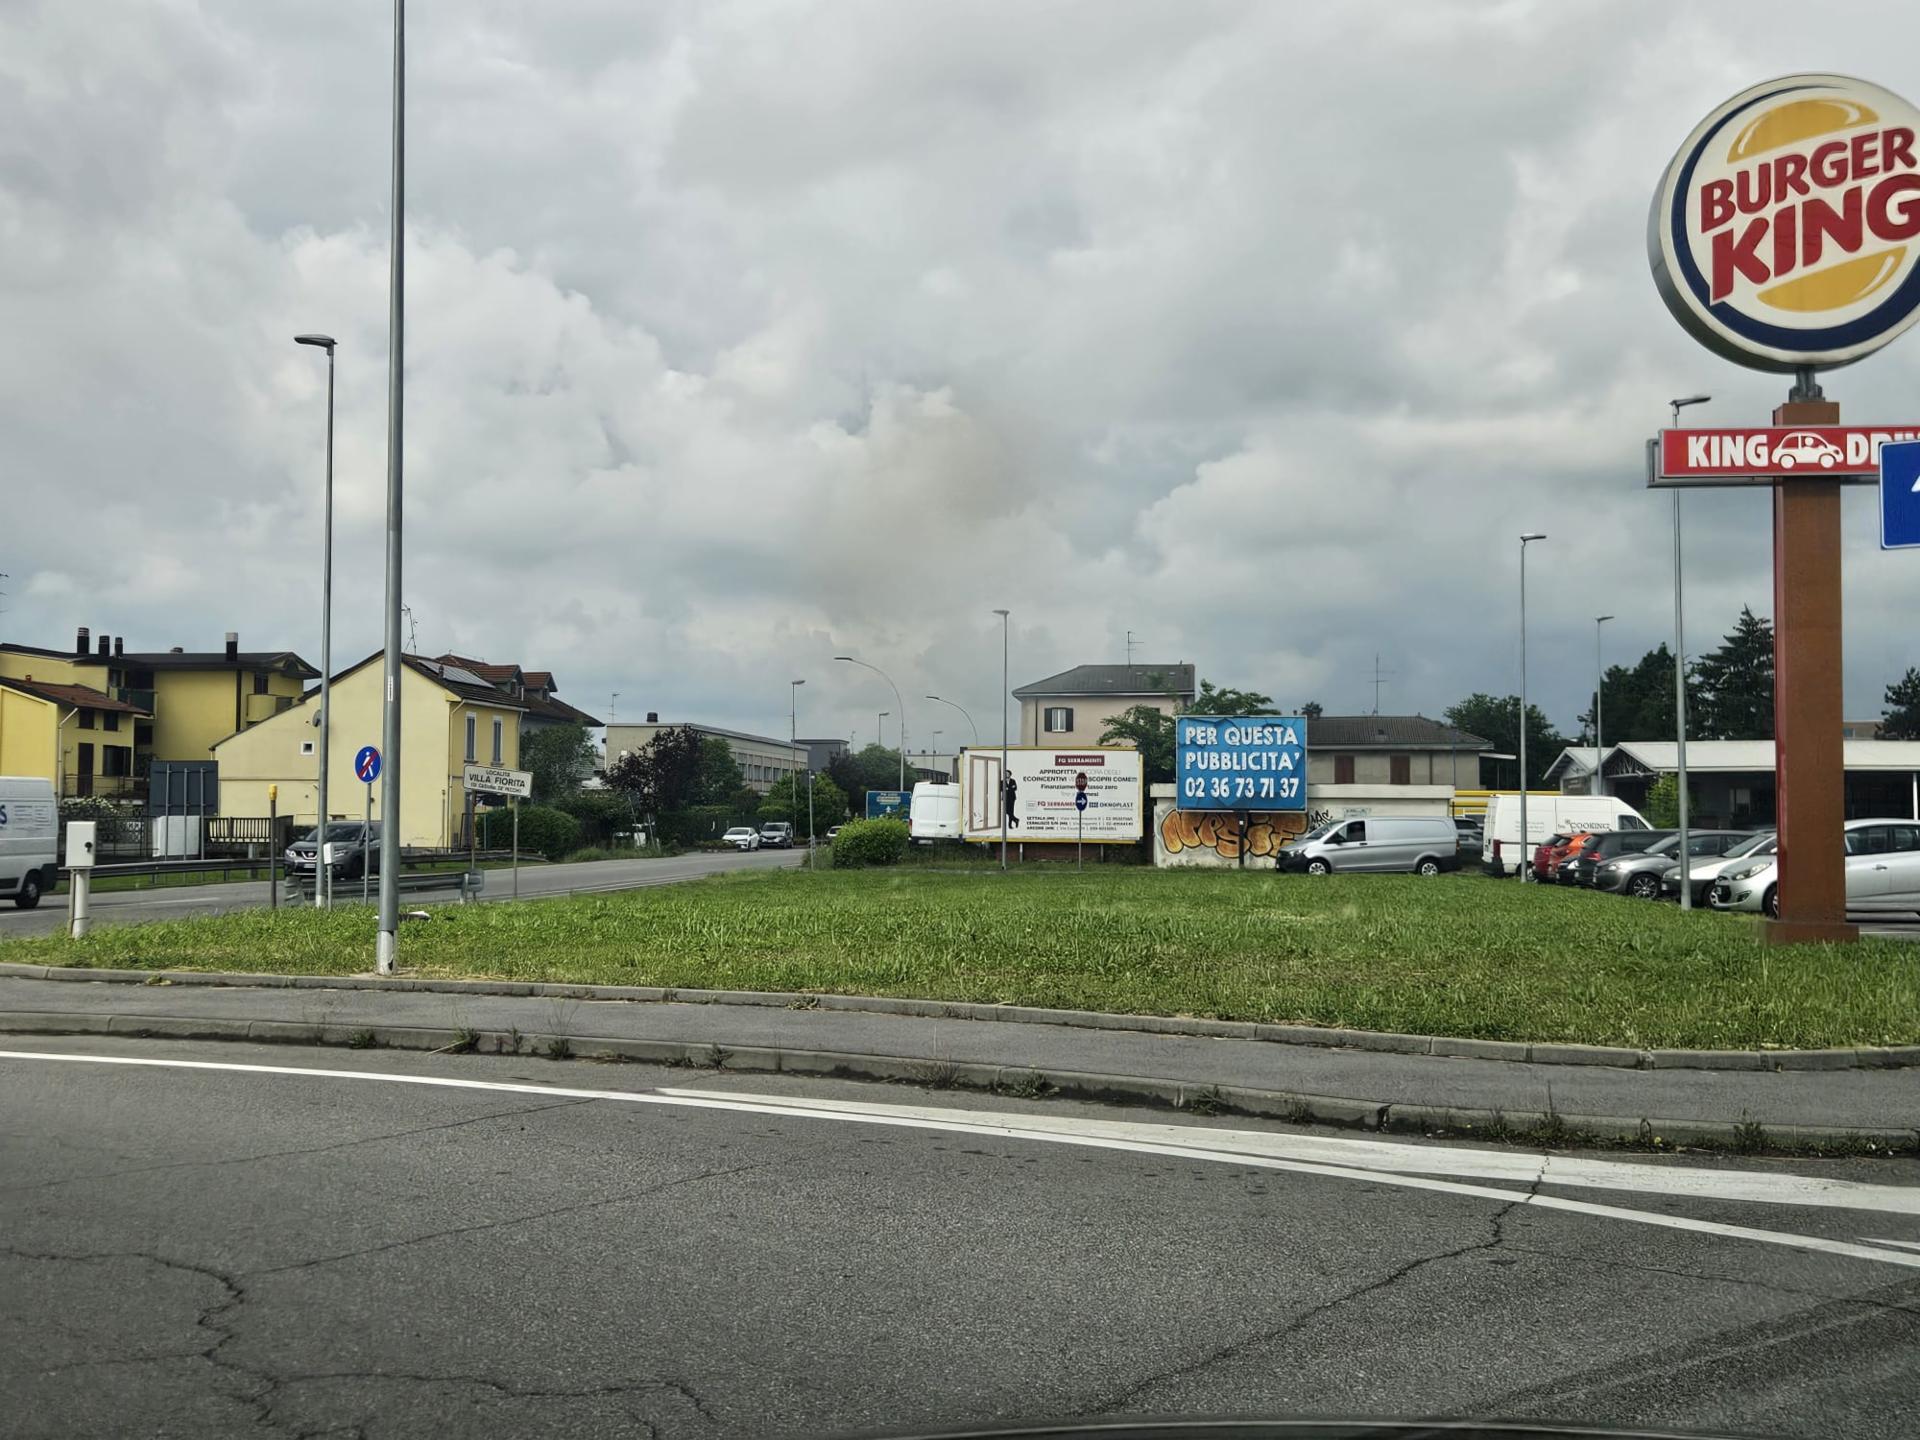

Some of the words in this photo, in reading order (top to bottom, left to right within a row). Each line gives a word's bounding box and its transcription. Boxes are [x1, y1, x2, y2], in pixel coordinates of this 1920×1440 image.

[1700, 126, 1918, 233] BURGER
[1711, 173, 1920, 301] KING
[1687, 434, 1768, 468] KING
[1184, 726, 1218, 745] PER
[1224, 726, 1299, 746] QUESTA
[1184, 751, 1300, 771] PUBBLICITA'
[469, 774, 490, 783] VILLA
[495, 777, 525, 787] FIORITA
[1185, 777, 1205, 798] 02
[1210, 777, 1230, 798] 36
[1235, 777, 1254, 798] 73
[1260, 777, 1274, 798] 71
[1279, 777, 1300, 798] 37
